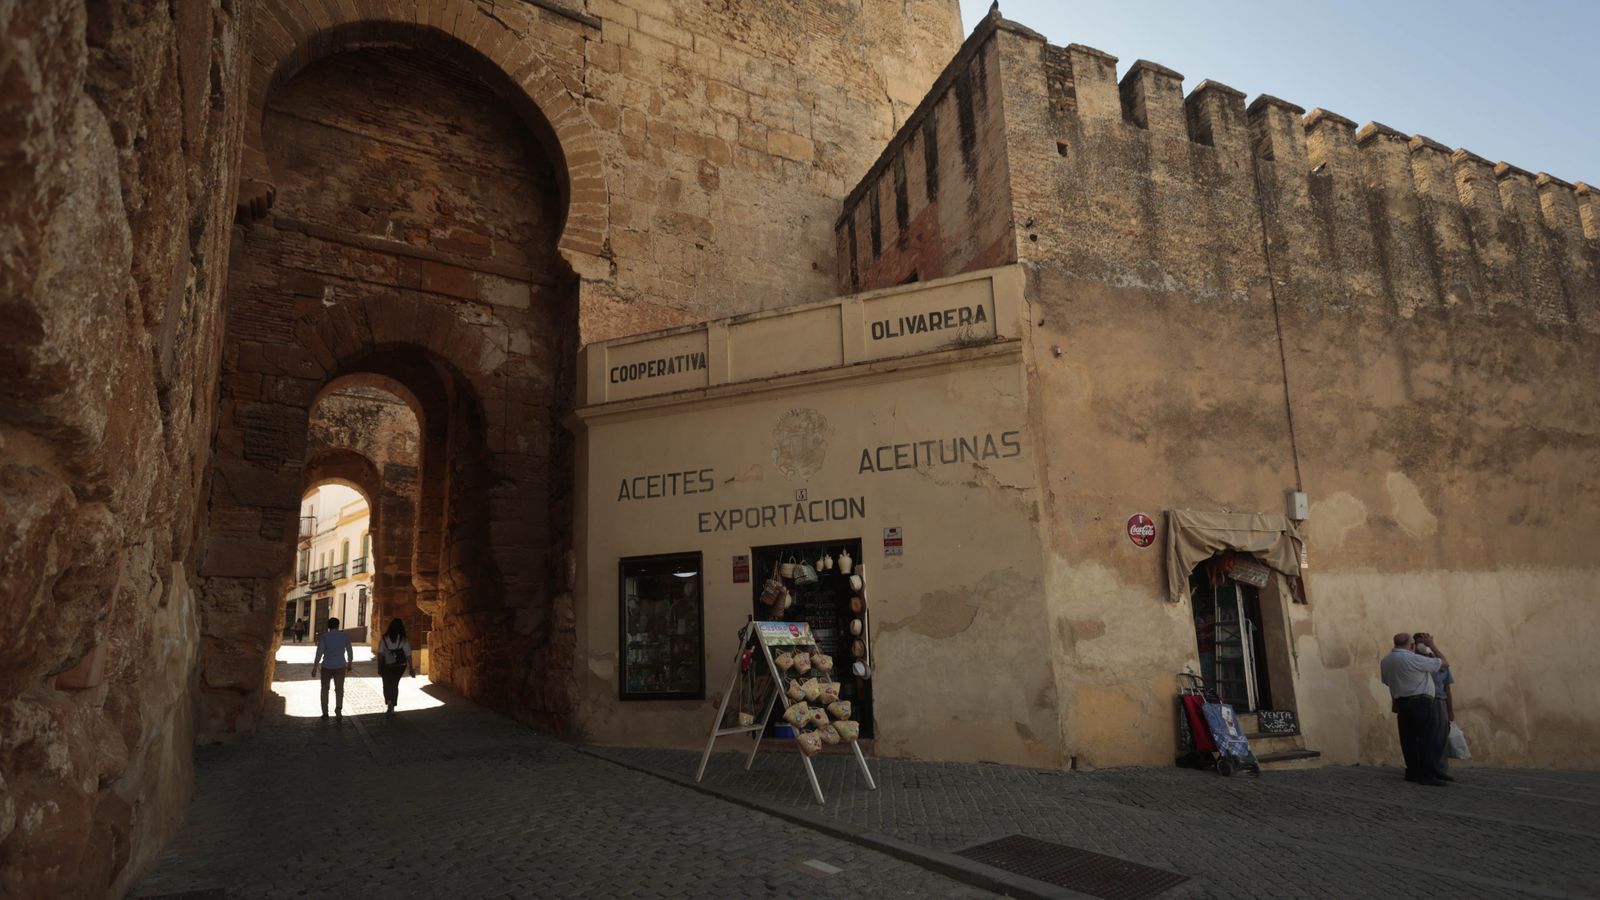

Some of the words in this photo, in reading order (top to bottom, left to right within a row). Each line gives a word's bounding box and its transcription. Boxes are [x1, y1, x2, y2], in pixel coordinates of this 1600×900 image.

[871, 304, 987, 341] OLIVARERA
[610, 352, 706, 384] COOPERATIVA
[858, 431, 1021, 474] ACEITUNAS
[617, 468, 714, 502] ACEITES
[698, 496, 865, 533] EXPORTACION
